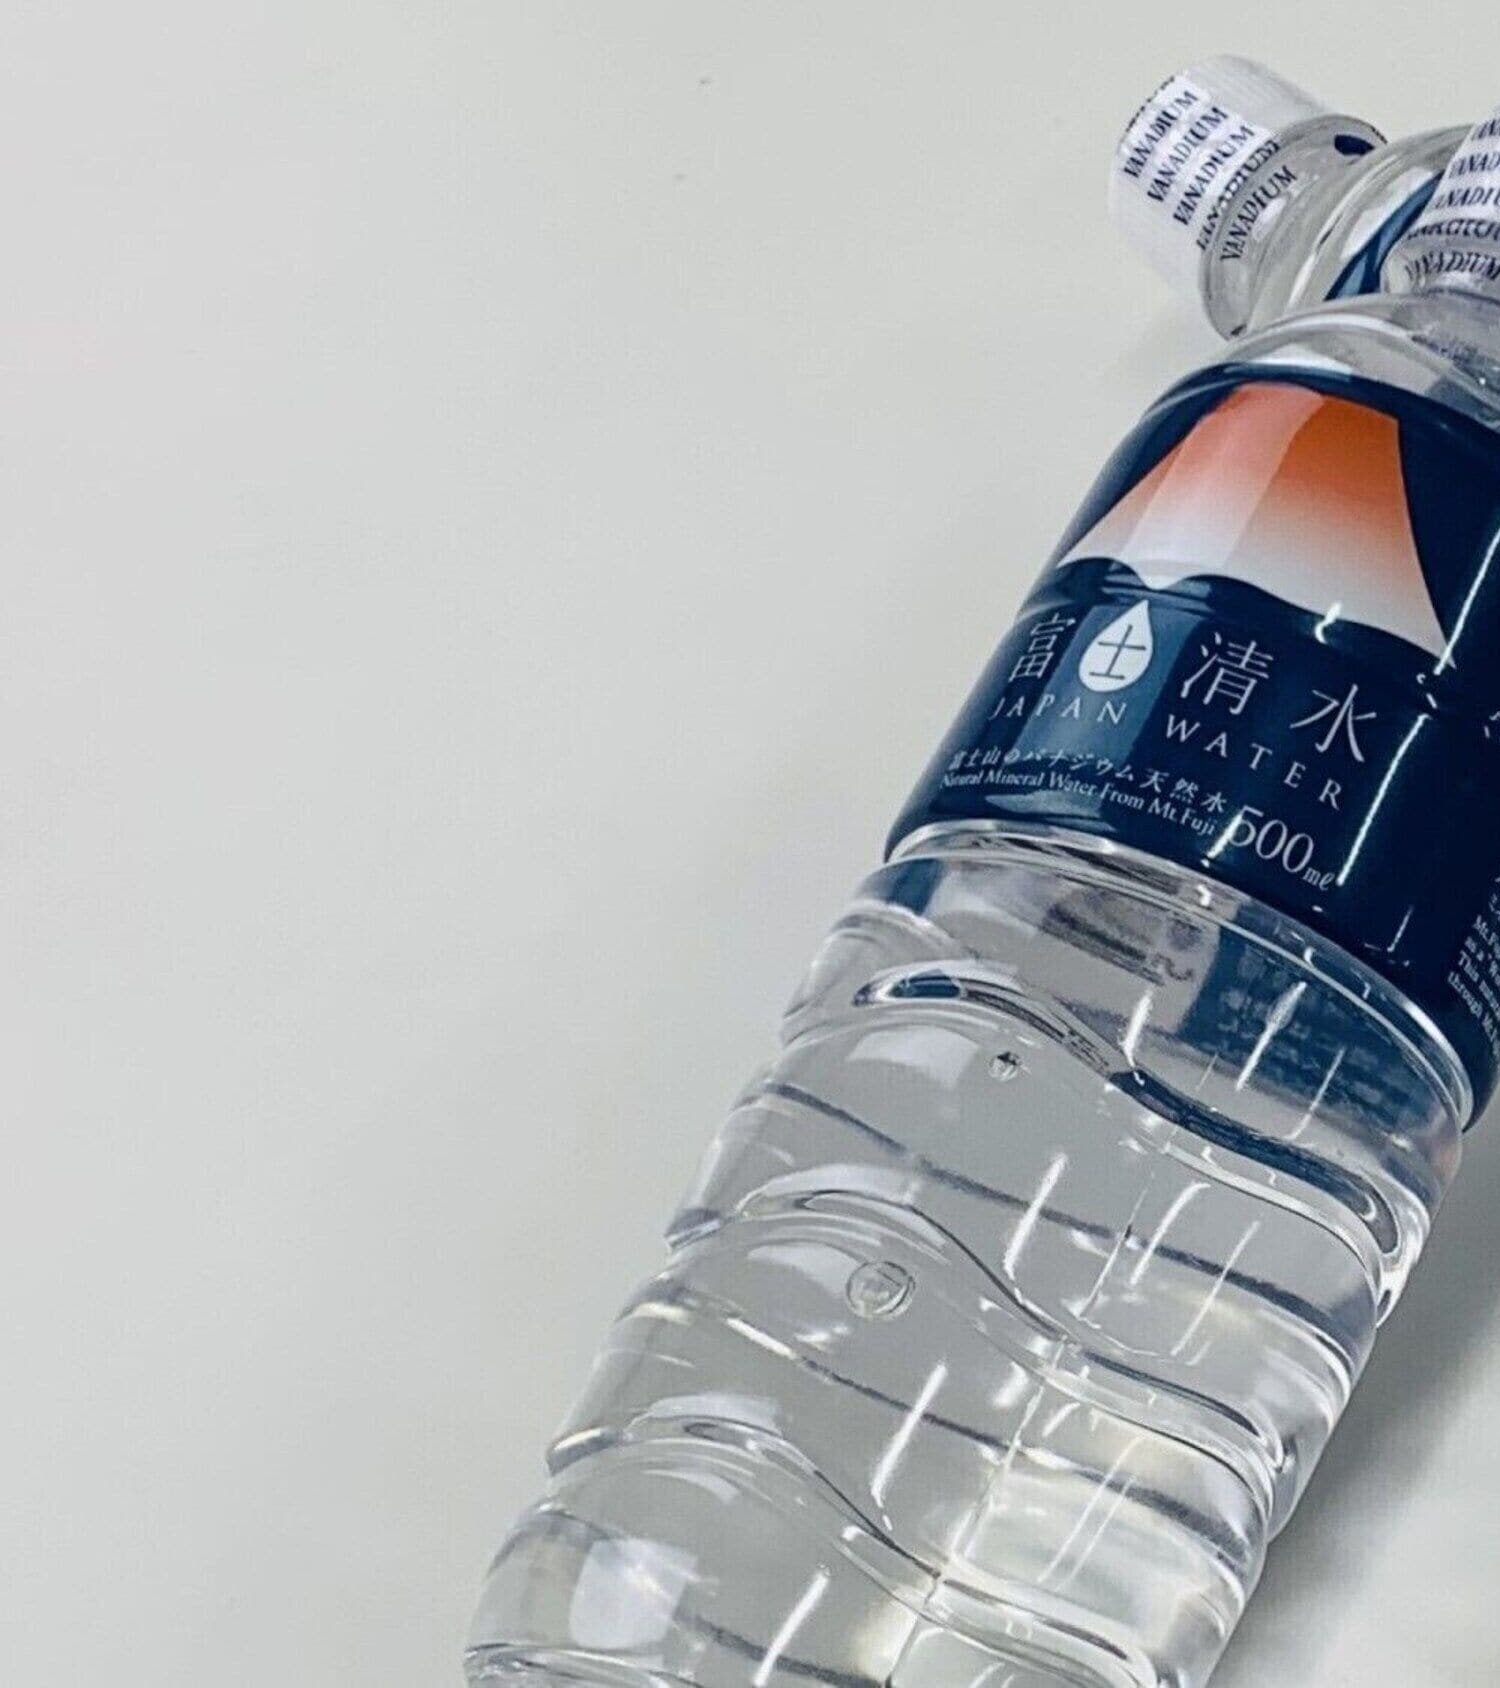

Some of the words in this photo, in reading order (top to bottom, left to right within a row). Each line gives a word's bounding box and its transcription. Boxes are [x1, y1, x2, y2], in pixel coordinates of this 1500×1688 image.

[1124, 90, 1198, 178] VANADIUM
[1147, 106, 1228, 202] VANADIUM
[1173, 125, 1254, 226] VANADIUM
[1220, 164, 1297, 262] VANADIUM
[1008, 611, 1377, 763] 富士清水
[984, 768, 1045, 787] Mineral
[1049, 770, 1098, 797] Water
[1099, 782, 1145, 811] From
[988, 696, 1126, 725] JAPAN
[1165, 714, 1342, 811] WATER
